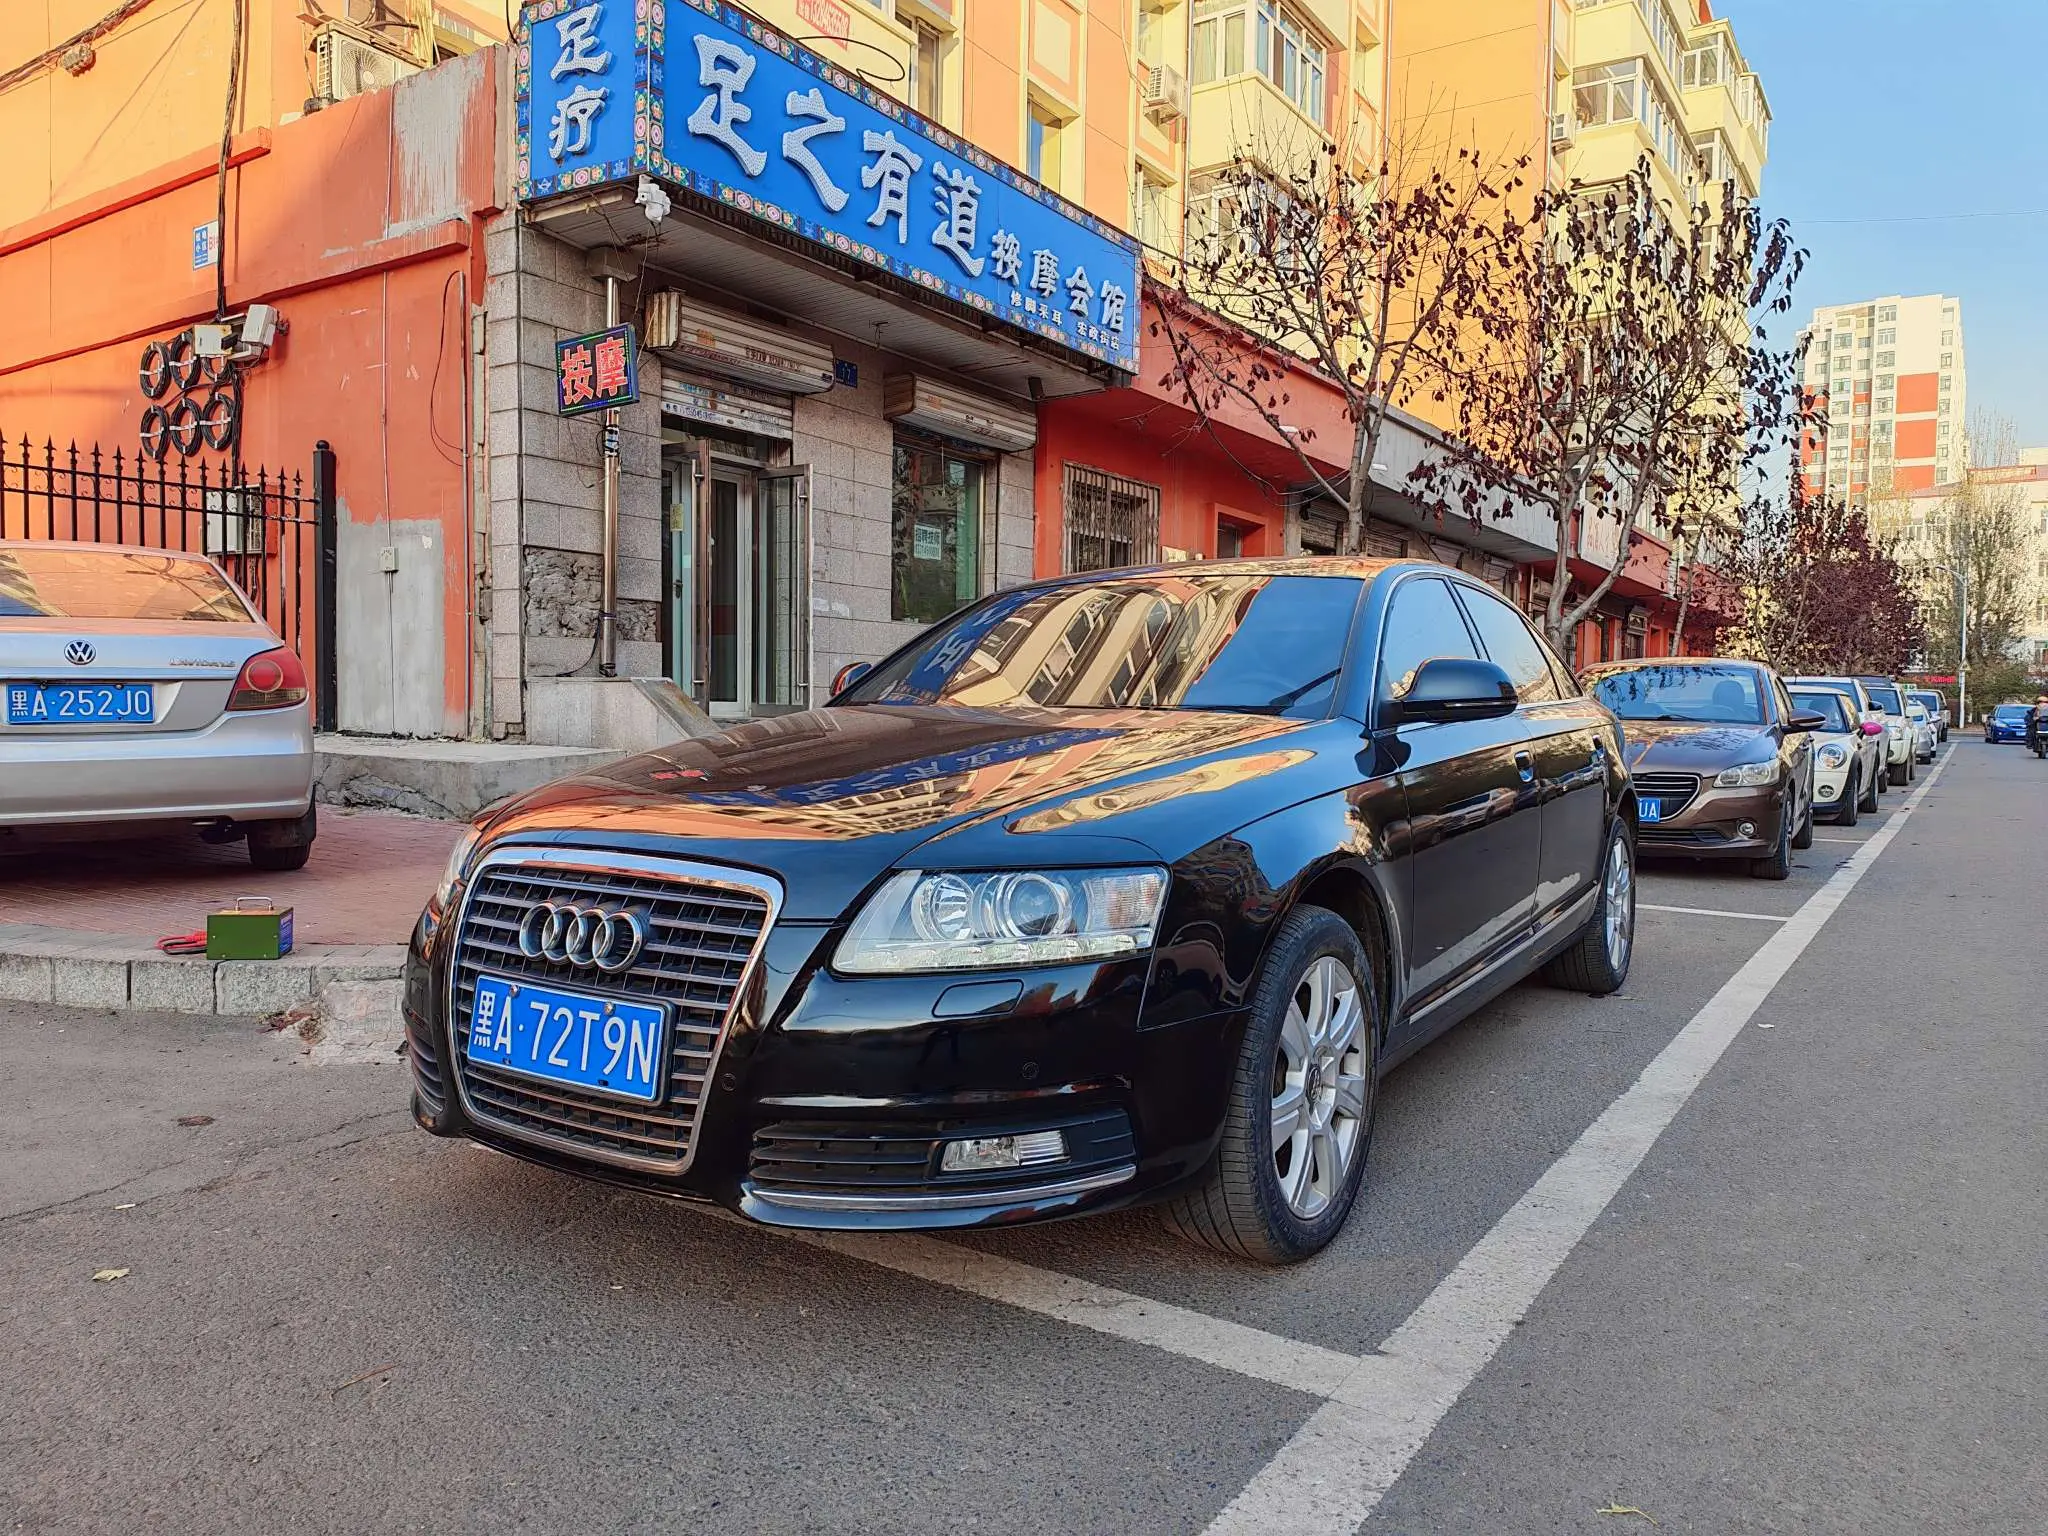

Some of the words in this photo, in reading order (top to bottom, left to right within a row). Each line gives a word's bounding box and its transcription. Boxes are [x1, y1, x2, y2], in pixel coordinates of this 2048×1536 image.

[549, 3, 613, 159] 足疗
[688, 34, 985, 277] 足之有道
[991, 229, 1126, 332] 按摩会馆
[561, 337, 628, 405] 按摩
[474, 990, 656, 1084] 黑A·72T9N
